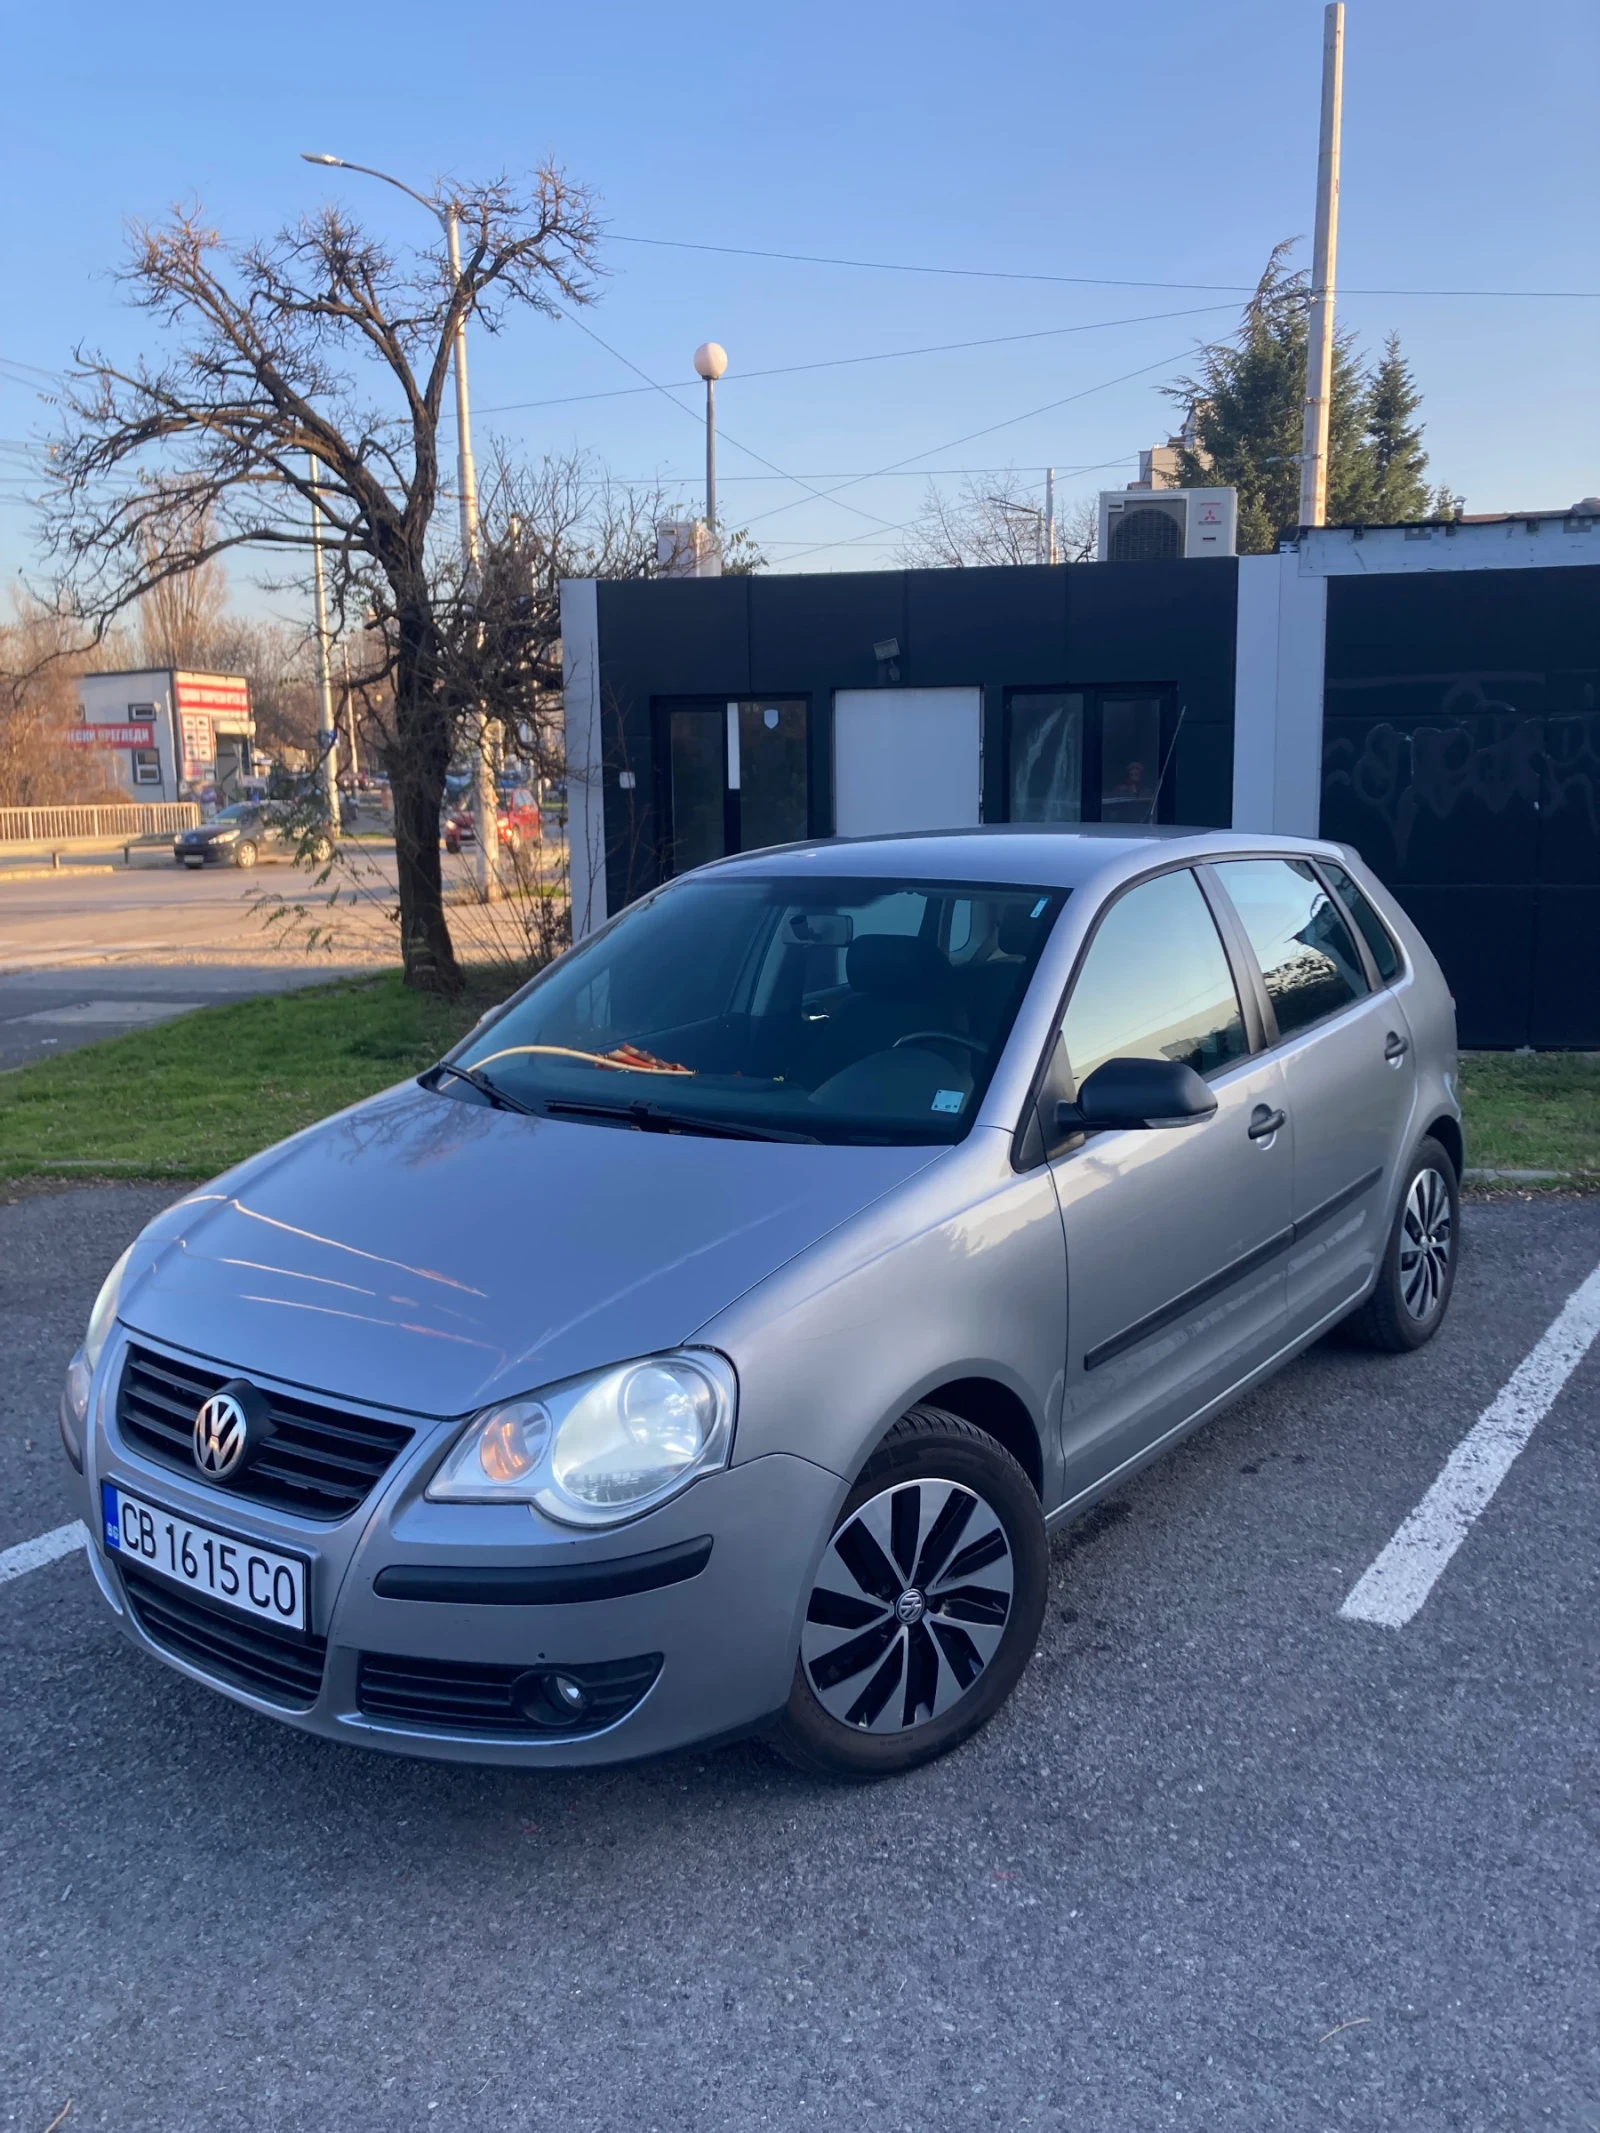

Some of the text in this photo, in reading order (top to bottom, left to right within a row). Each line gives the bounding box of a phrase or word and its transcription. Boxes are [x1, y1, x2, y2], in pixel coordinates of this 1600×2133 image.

[107, 1521, 119, 1540] BG
[122, 1501, 157, 1558] CB
[165, 1522, 240, 1596] 1615
